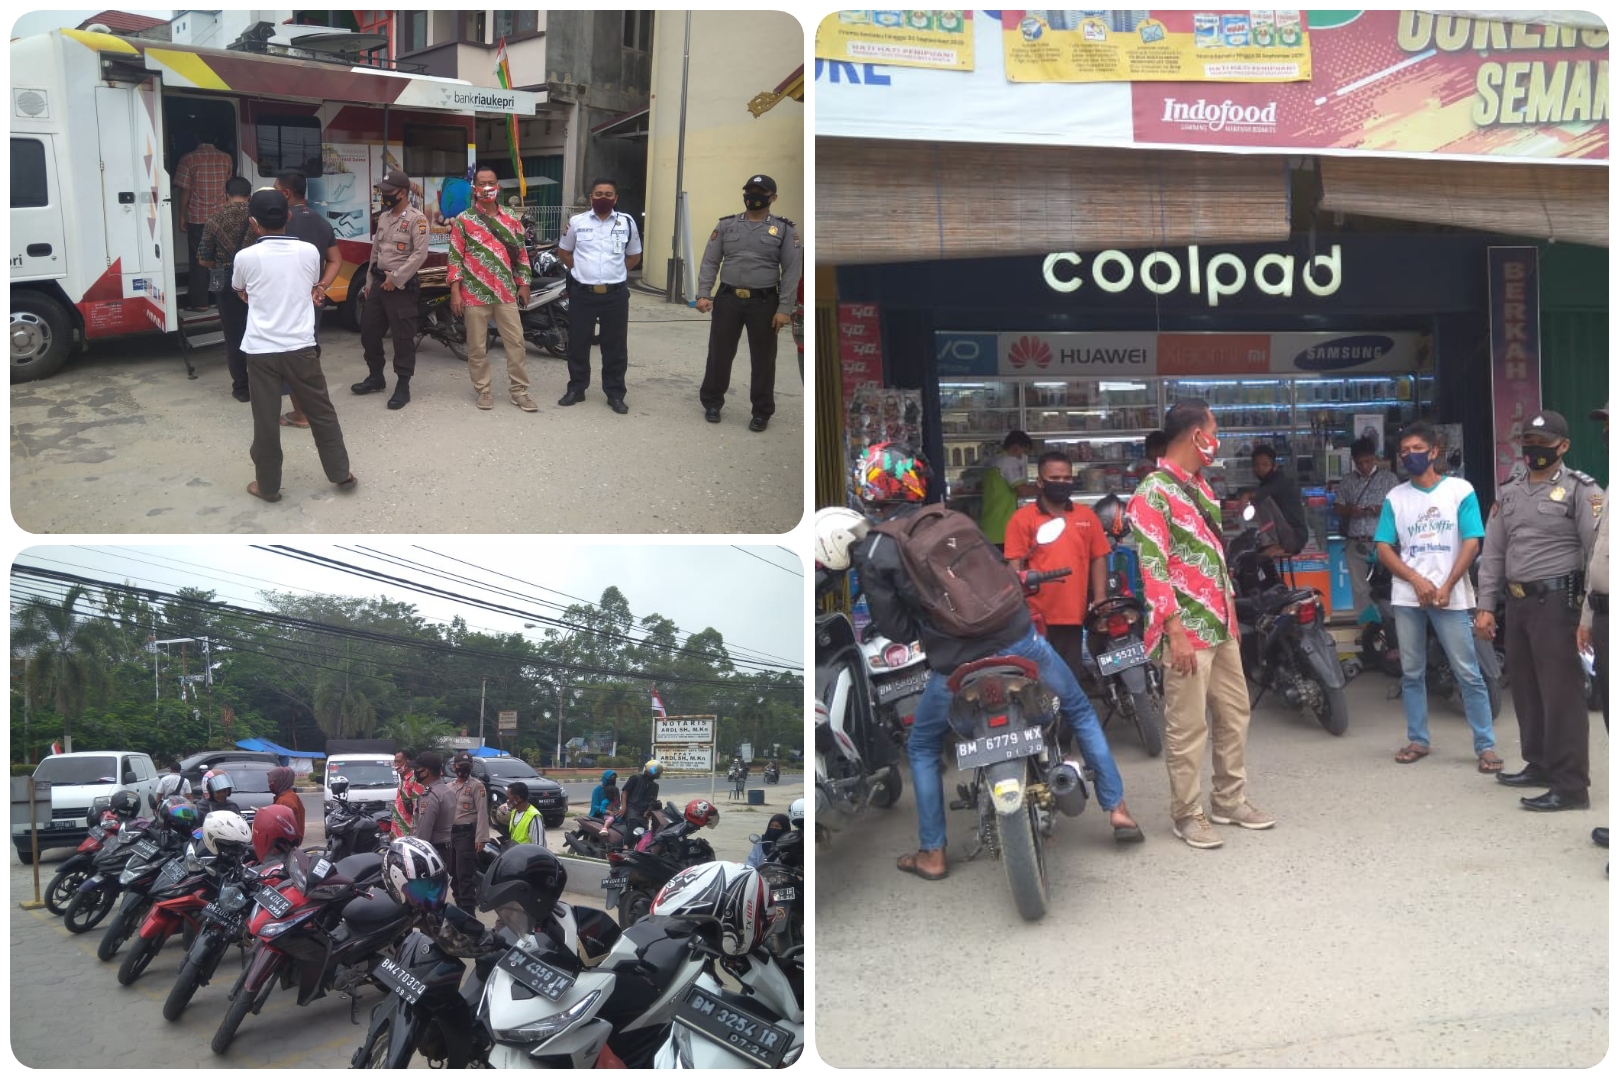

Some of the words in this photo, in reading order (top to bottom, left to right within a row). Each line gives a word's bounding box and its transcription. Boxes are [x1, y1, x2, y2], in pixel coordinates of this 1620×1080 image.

[1161, 97, 1277, 131] Indofood
[1042, 244, 1342, 306] coolpad
[1503, 261, 1528, 380] BERKAH
[1060, 349, 1147, 364] HUAWEI
[1307, 347, 1382, 360] SAMSUNG
[1100, 655, 1113, 665] BM
[960, 741, 977, 756] BM
[986, 733, 1018, 750] 6779
[1024, 728, 1041, 741] WX
[508, 951, 527, 966] BM
[525, 962, 554, 981] 4356
[395, 986, 405, 996] 09
[691, 995, 716, 1015] BM
[717, 1009, 759, 1037] 3254
[758, 1028, 778, 1048] IR
[730, 1033, 769, 1059] 07-24
